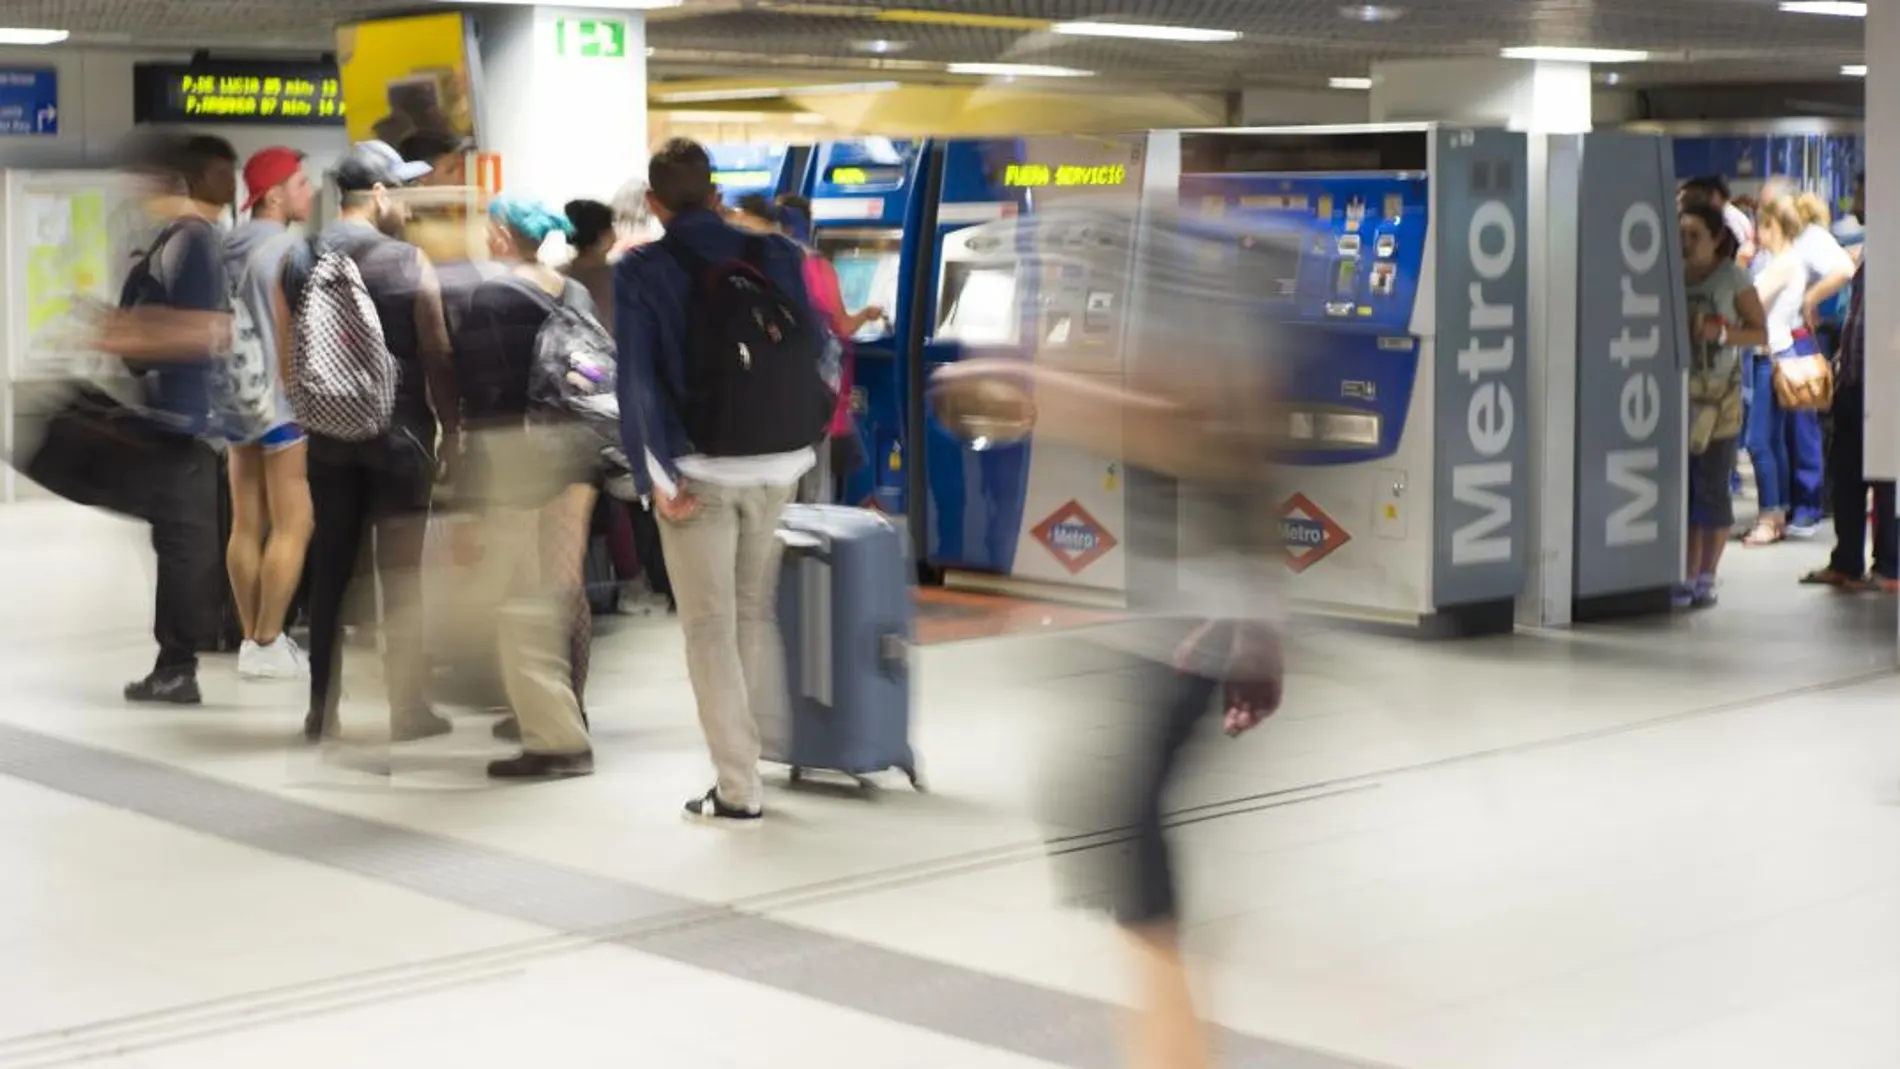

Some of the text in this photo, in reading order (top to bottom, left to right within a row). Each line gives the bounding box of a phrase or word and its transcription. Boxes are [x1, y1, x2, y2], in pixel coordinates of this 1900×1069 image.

[1053, 525, 1093, 550] Metro
[1452, 199, 1516, 565] Metro
[1605, 201, 1661, 547] Metro
